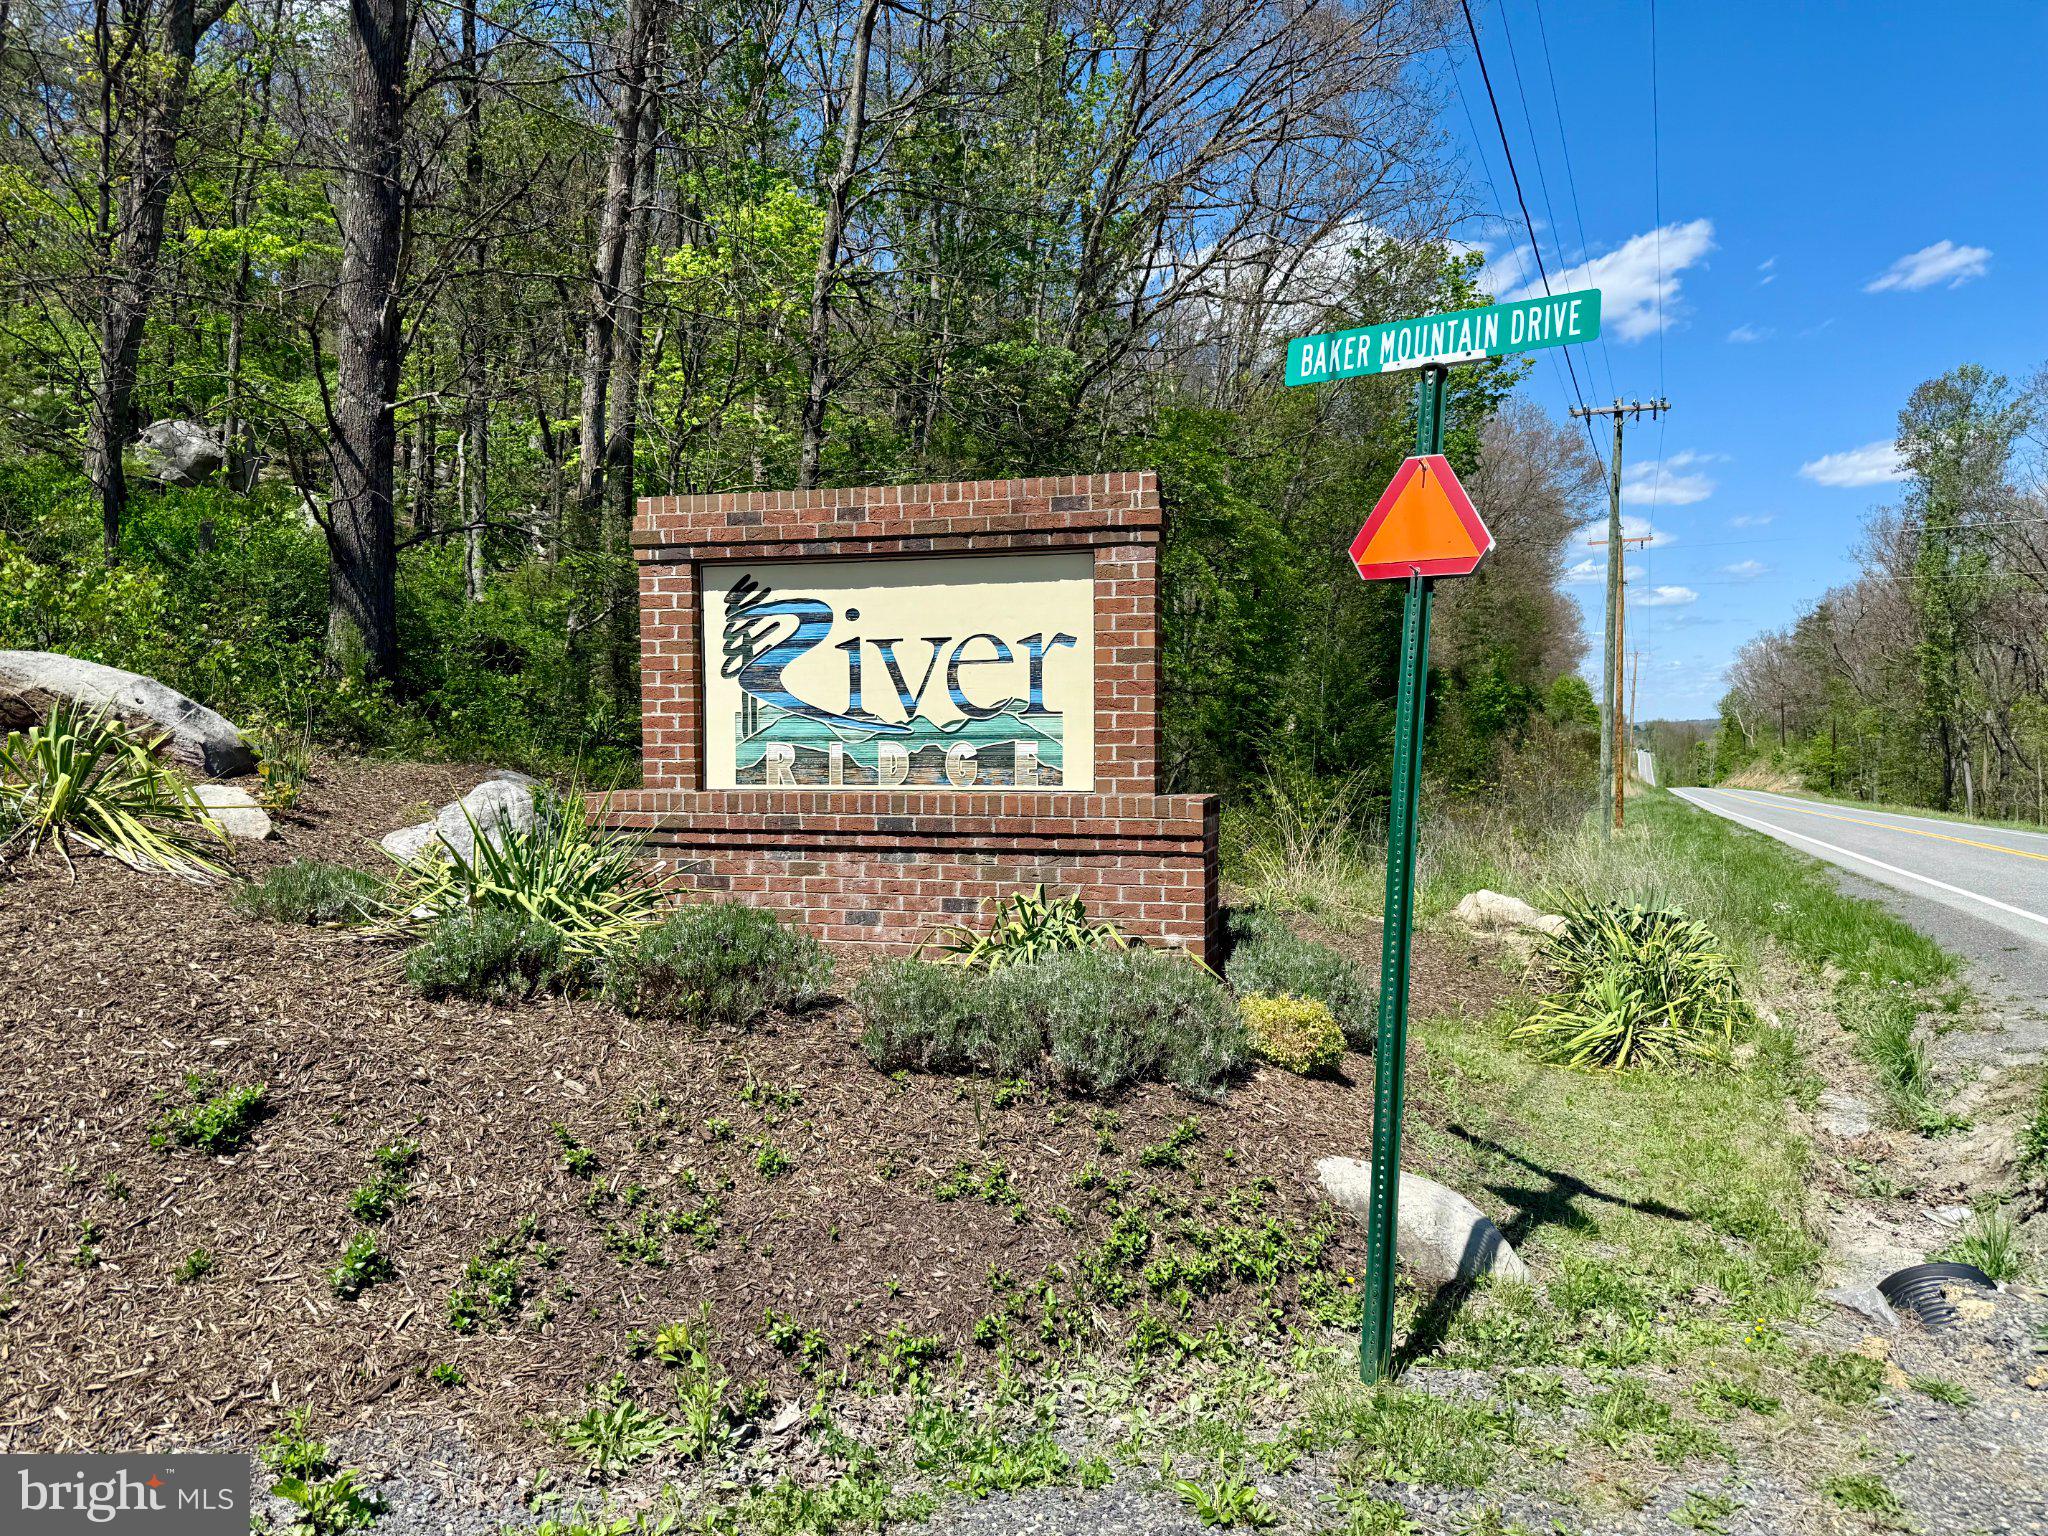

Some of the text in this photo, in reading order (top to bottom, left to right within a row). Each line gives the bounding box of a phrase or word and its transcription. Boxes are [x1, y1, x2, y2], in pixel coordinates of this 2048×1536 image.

[1301, 300, 1582, 377] BAKER MOUNTAIN DRIVE
[728, 598, 1077, 733] River
[766, 741, 1039, 787] RIDGE
